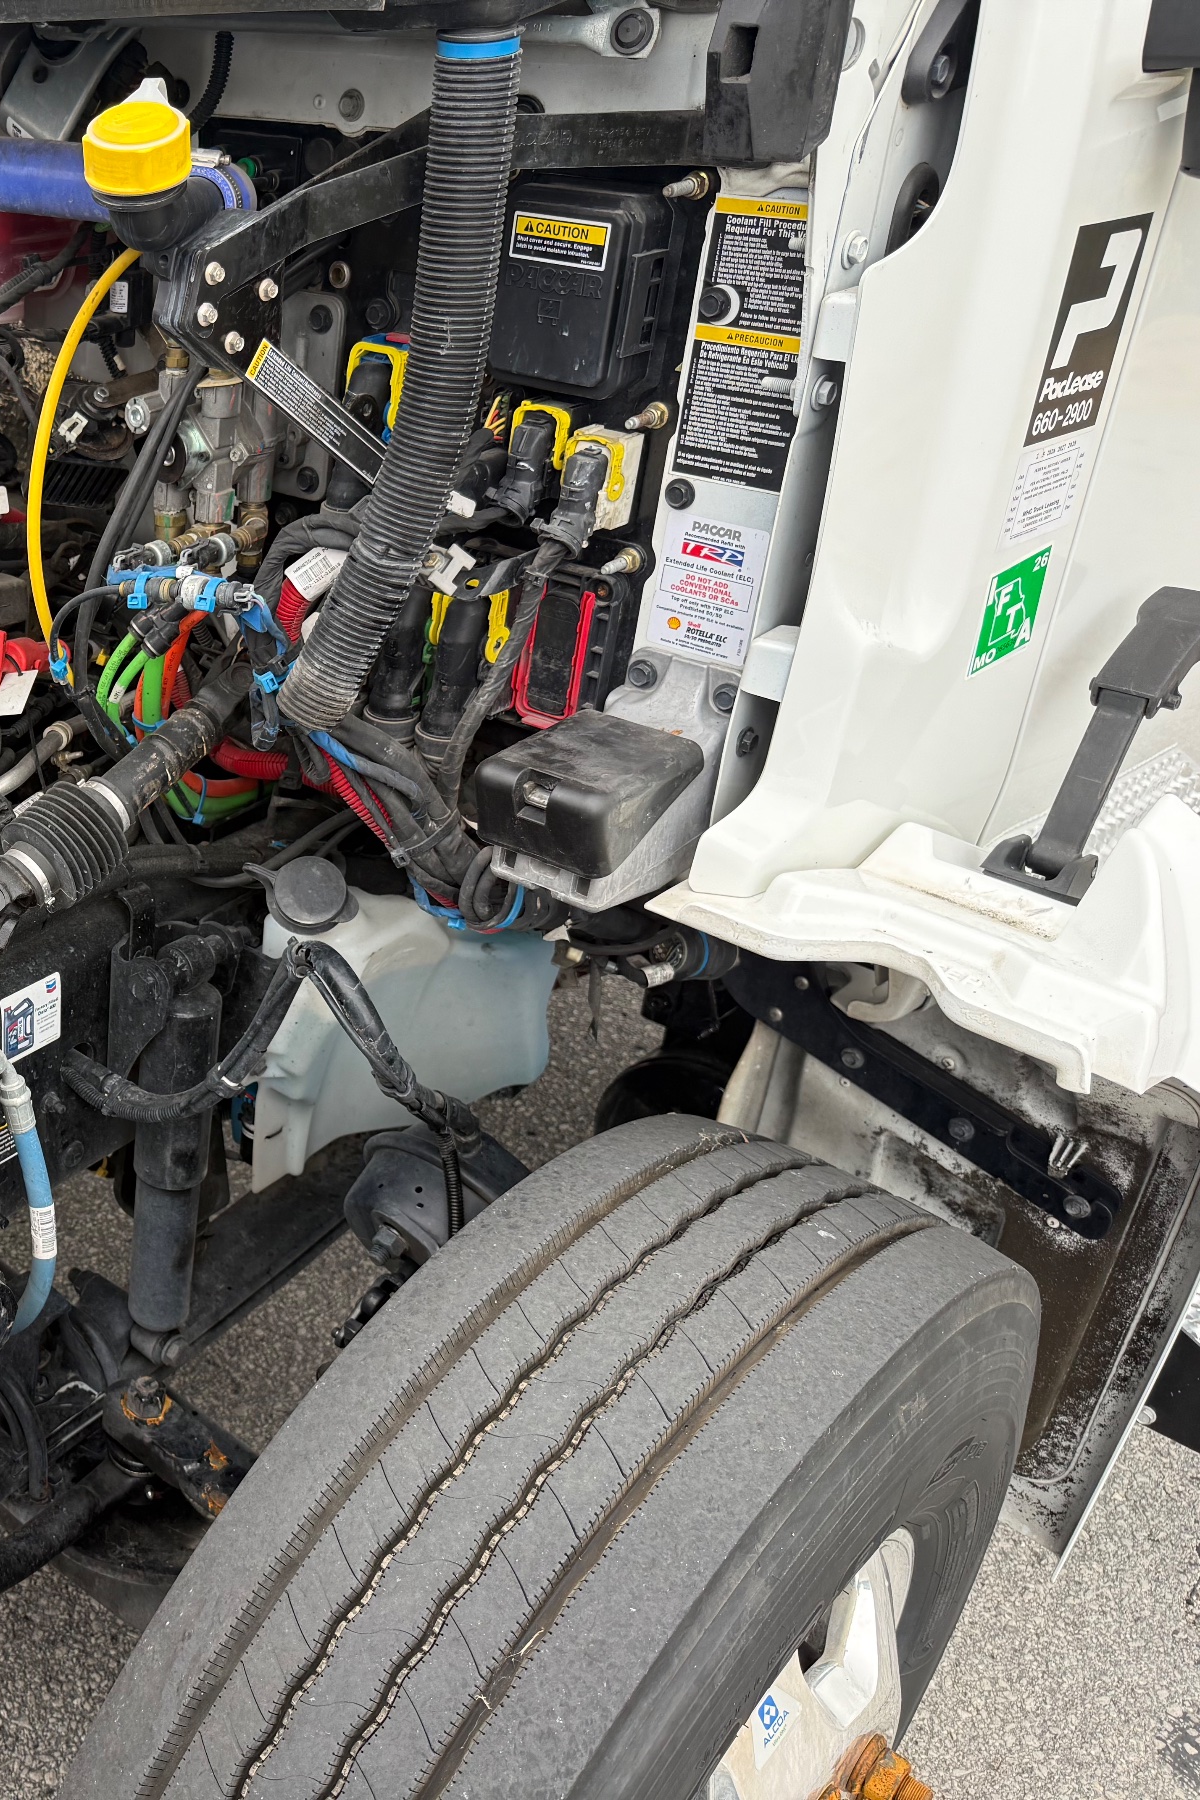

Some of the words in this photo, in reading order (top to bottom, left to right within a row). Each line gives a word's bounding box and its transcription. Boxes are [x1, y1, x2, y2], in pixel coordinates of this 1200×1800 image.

[765, 204, 800, 216] CAUTION
[726, 215, 757, 227] Coolant
[759, 218, 772, 228] Fill
[536, 222, 589, 240] CAUTION
[725, 224, 760, 236] Required
[762, 228, 776, 237] For
[778, 229, 795, 239] This
[533, 244, 546, 252] avoid
[547, 247, 567, 255] moisture
[554, 241, 572, 249] secure.
[574, 243, 593, 252] Engage
[505, 262, 603, 299] PACCAR
[734, 333, 784, 347] PRECAUCION
[249, 344, 268, 376] CAUTION
[268, 348, 285, 367] Extended
[700, 350, 707, 358] De
[707, 352, 741, 363] Refrigerante
[751, 358, 763, 366] Este
[769, 352, 783, 360] Para
[1039, 370, 1104, 403] PacLease
[1032, 398, 1093, 436] 660-2900
[685, 532, 719, 543] Recommended
[692, 521, 742, 542] PACCAR
[685, 542, 744, 562] TRP
[665, 557, 694, 568] Extended
[696, 564, 708, 572] Life
[709, 567, 734, 579] Coolant
[735, 573, 754, 584] (ELC)
[1032, 552, 1049, 572] 26
[679, 580, 732, 598] CONVENTIONAL
[698, 576, 712, 585] NOT
[713, 580, 729, 590] ADD
[670, 584, 706, 598] COOLANTS
[708, 594, 719, 602] OR
[720, 596, 739, 607] SCAs
[689, 599, 699, 608] only
[700, 602, 711, 610] with
[706, 609, 723, 619] 50/50
[687, 621, 701, 629] Shell
[716, 634, 728, 644] ELC
[972, 648, 996, 671] MO
[764, 1710, 790, 1748] ALCOA
